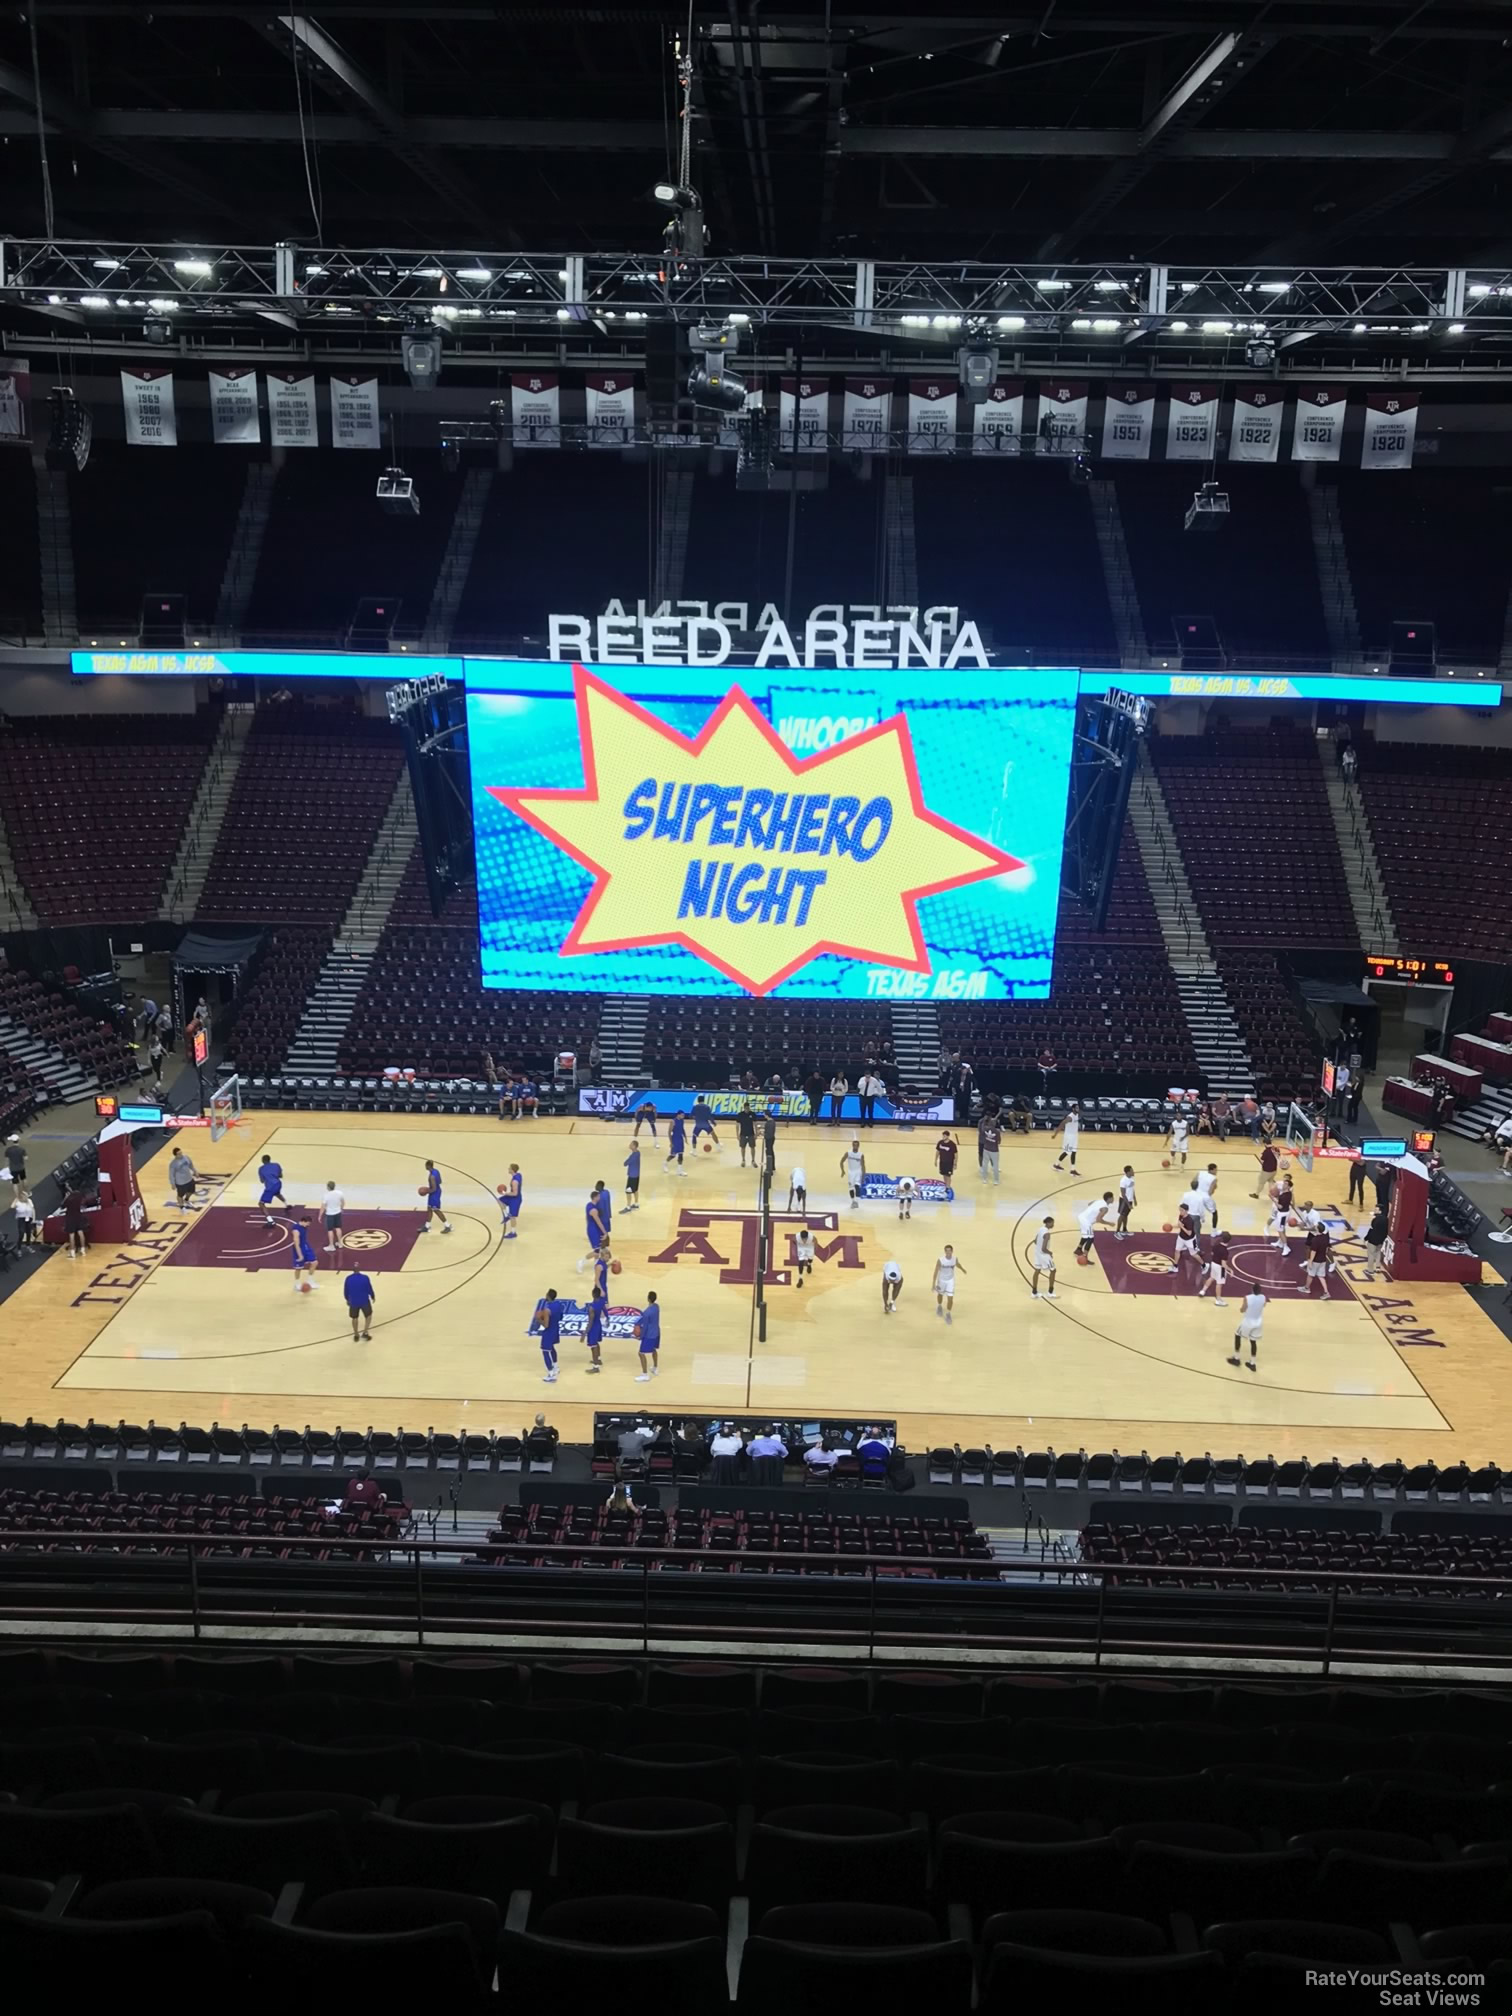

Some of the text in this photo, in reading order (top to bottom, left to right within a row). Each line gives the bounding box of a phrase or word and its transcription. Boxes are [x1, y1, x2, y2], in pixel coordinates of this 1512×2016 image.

[138, 394, 160, 404] 1969
[139, 416, 162, 425] 2007
[595, 416, 625, 428] 1987
[851, 419, 881, 433] 1976
[917, 421, 948, 434] 1975
[141, 426, 162, 437] 2016
[1051, 424, 1076, 437] 964
[1113, 426, 1142, 441] 1951
[1176, 427, 1207, 441] 1923
[1239, 428, 1270, 443] 1922
[1303, 428, 1331, 442] 1921
[1372, 436, 1405, 451] 1920
[547, 613, 991, 669] REED ARENA
[92, 654, 127, 673] TEXAS
[129, 654, 158, 673] A&M
[1171, 676, 1203, 694] TEXAS
[1205, 677, 1233, 694] A&M
[1257, 678, 1289, 695] UCSB
[779, 715, 875, 751] WHOOP!
[623, 777, 893, 863] SUPERHERO
[677, 858, 828, 927] NIGHT
[1376, 966, 1384, 976] 0
[1445, 972, 1453, 982] 0
[865, 969, 989, 999] TEXAS A&M
[1416, 1140, 1431, 1150] 30
[70, 1221, 189, 1308] TEXAS
[1362, 1293, 1447, 1349] A&M
